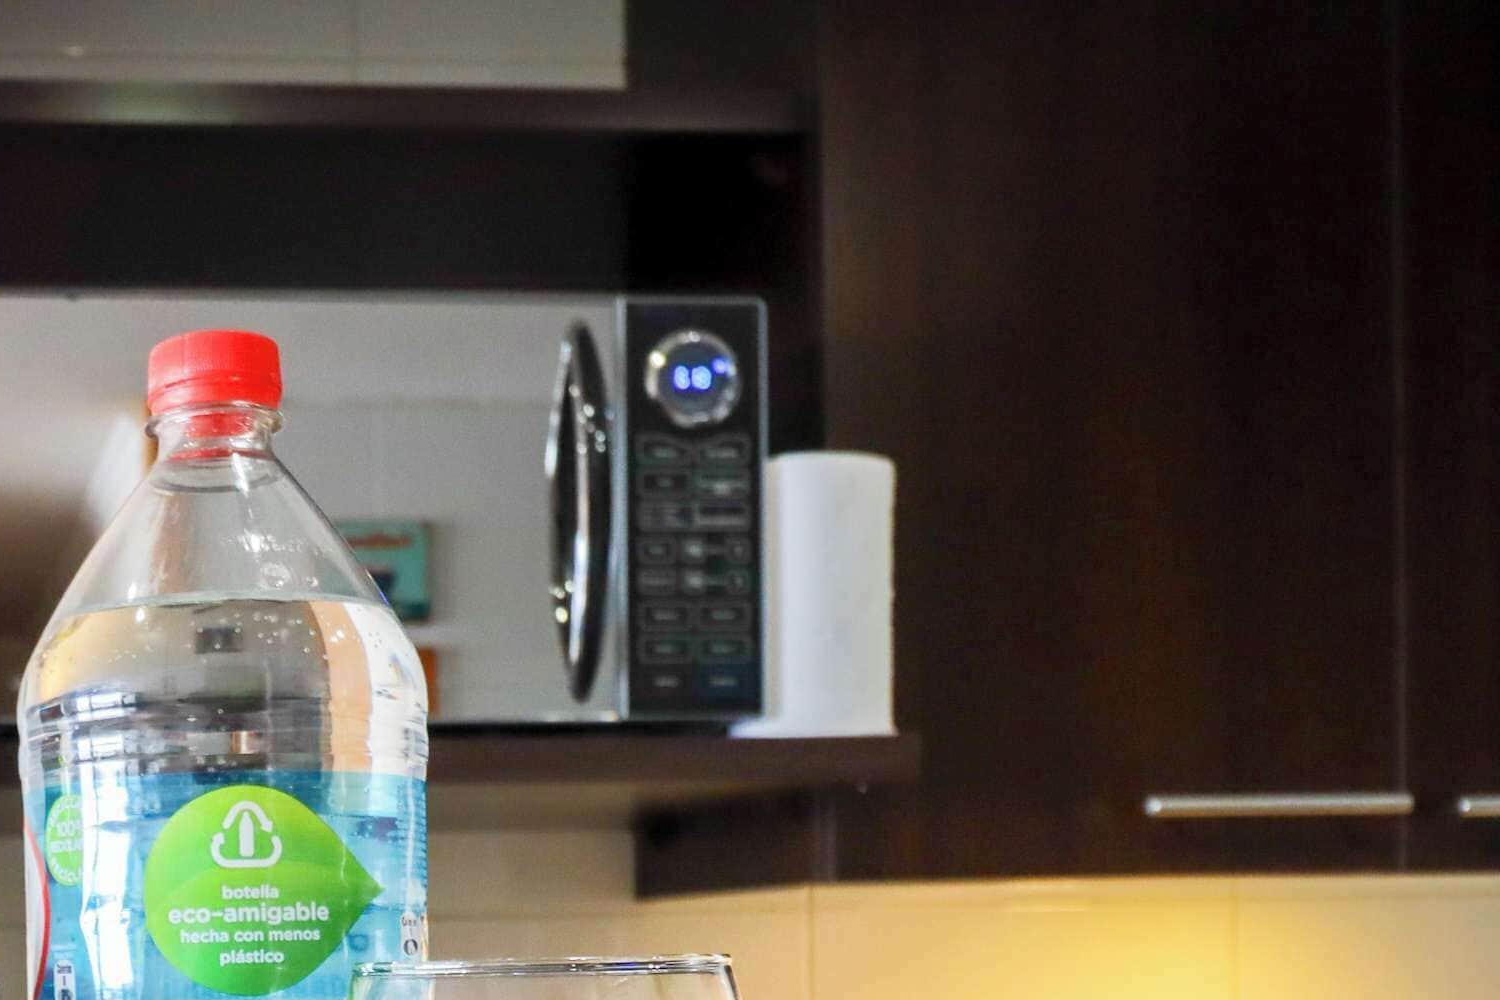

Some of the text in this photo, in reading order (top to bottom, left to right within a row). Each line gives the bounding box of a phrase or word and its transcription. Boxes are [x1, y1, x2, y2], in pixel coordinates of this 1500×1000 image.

[221, 884, 280, 899] botella
[167, 902, 330, 925] eco-amigable
[179, 928, 321, 944] hecha con menos
[219, 949, 285, 966] plástico
